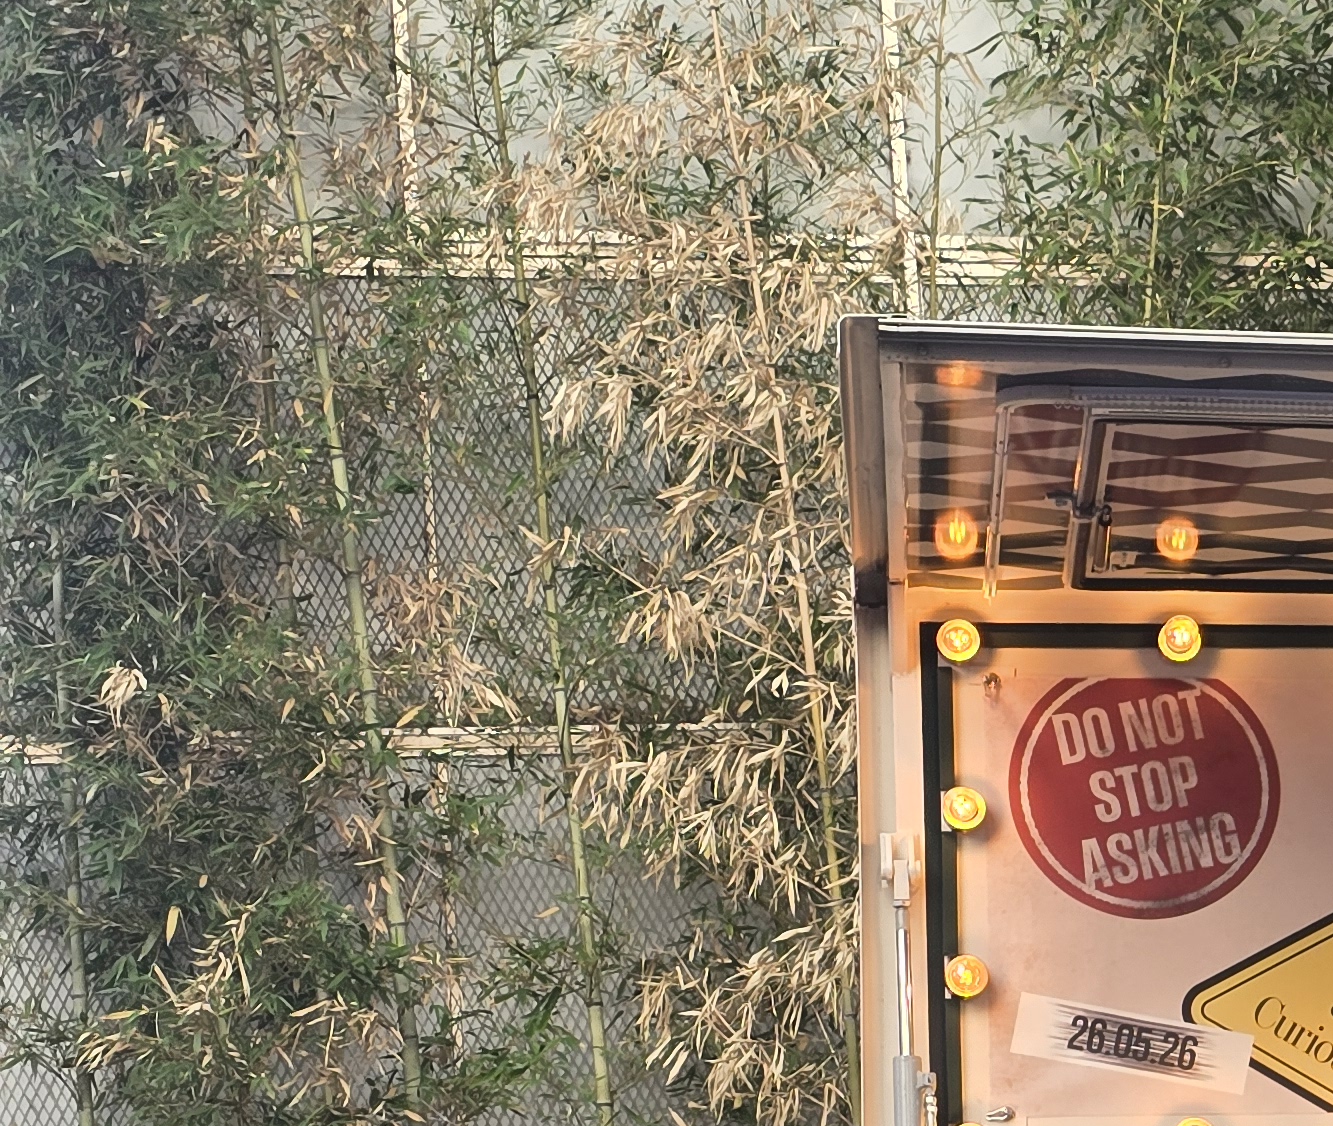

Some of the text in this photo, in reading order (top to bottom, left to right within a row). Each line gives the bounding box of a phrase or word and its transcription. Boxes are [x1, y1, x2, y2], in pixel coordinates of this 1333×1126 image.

[1051, 689, 1204, 766] DO NOT
[1089, 755, 1199, 823] STOP
[1082, 812, 1241, 890] ASKING
[1066, 1014, 1199, 1071] 26.05.26
